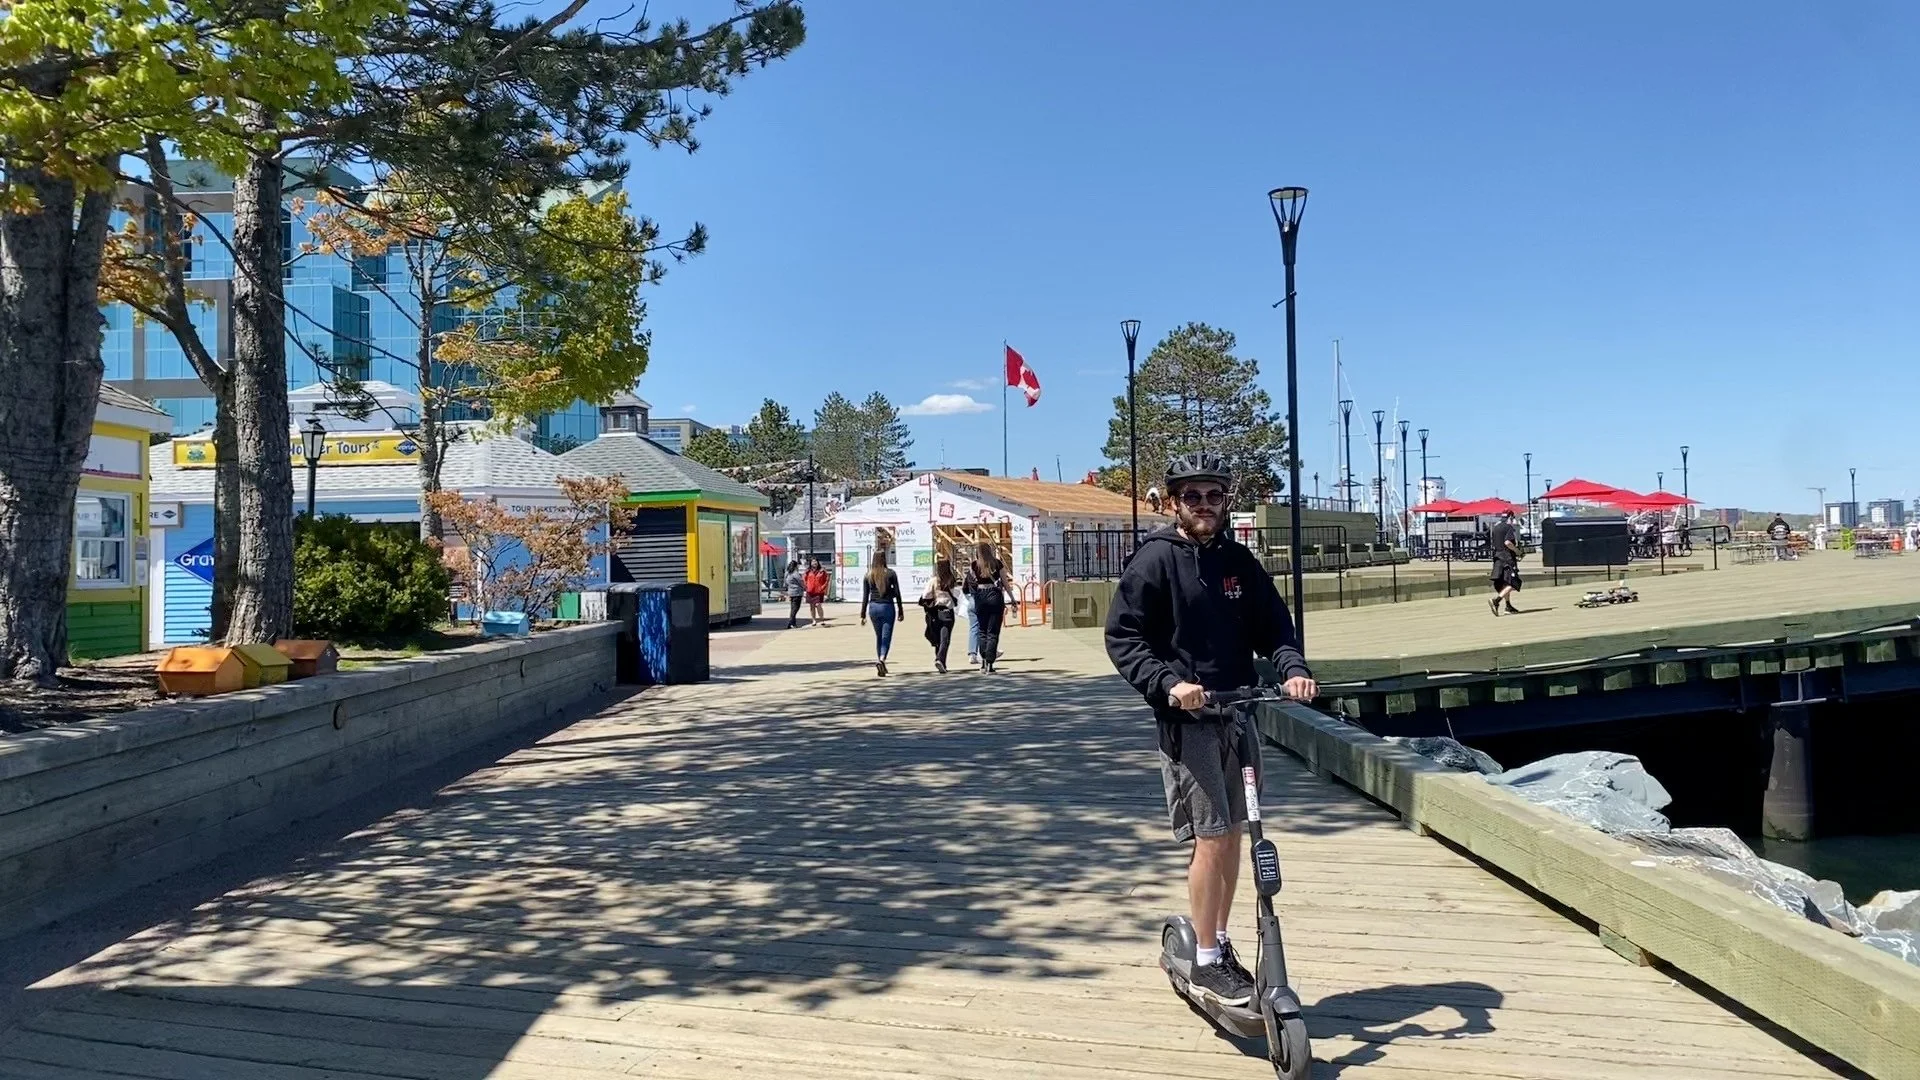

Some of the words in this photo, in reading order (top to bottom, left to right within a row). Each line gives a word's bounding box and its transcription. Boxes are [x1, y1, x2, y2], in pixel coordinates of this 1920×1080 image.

[336, 441, 370, 454] Tours
[876, 496, 900, 507] Tyvek
[511, 505, 532, 513] TOUR
[896, 528, 915, 539] yvek
